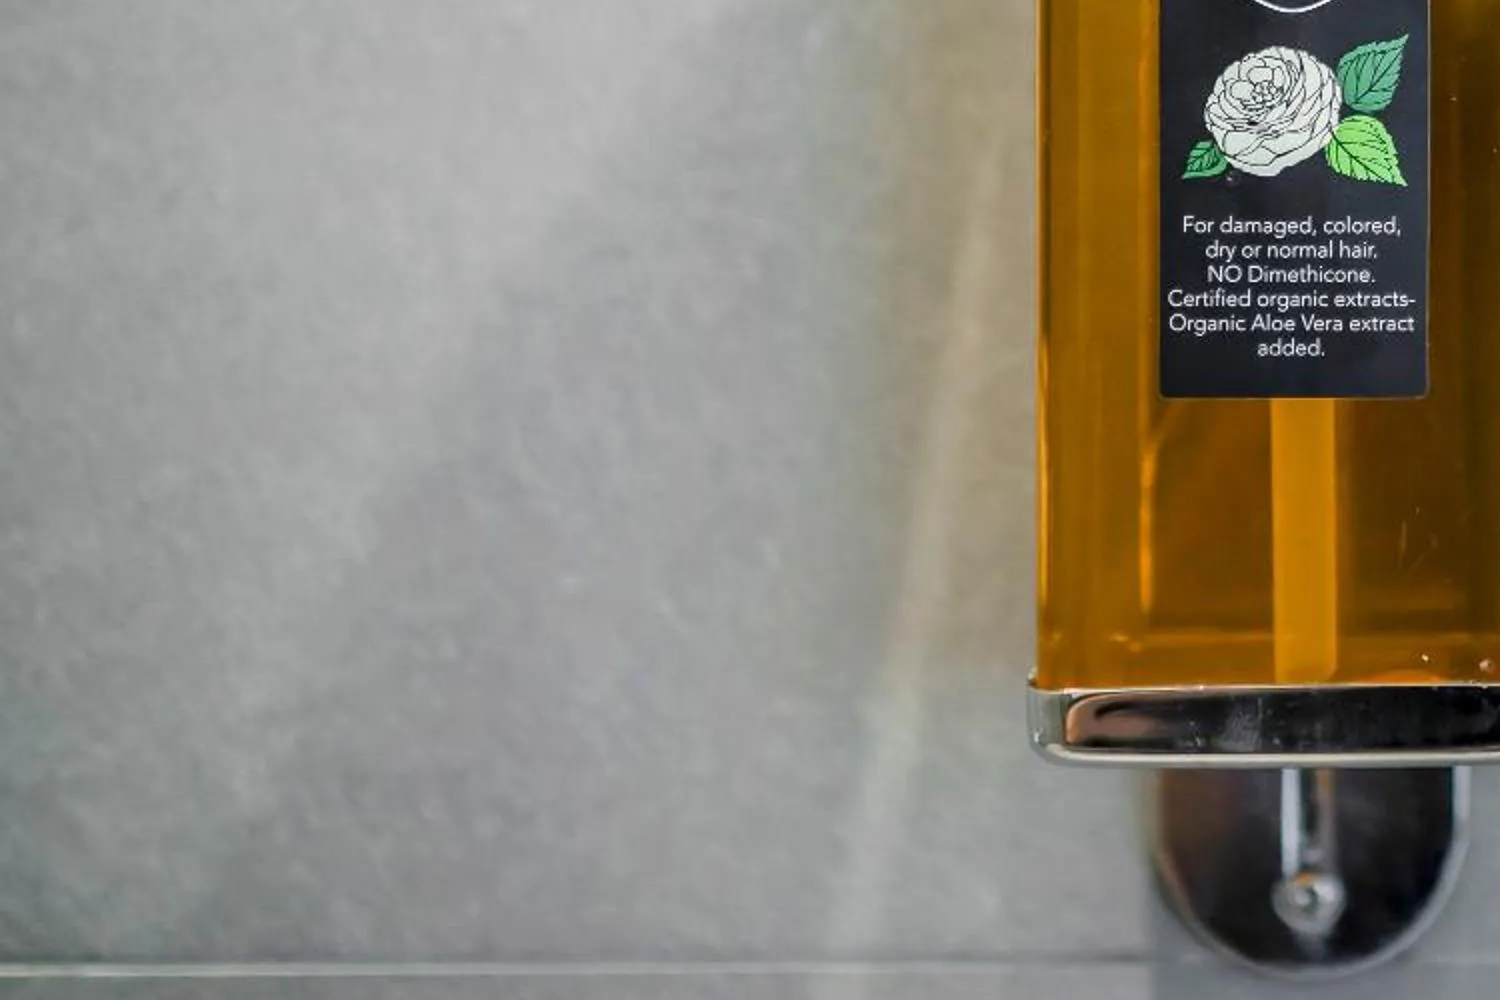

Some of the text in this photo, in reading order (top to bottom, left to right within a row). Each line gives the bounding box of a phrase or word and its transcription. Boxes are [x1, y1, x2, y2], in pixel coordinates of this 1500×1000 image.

[1183, 215, 1401, 238] For damaged, colored,
[1205, 240, 1377, 262] dry or normal hair.
[1207, 265, 1376, 283] NO Dimethicone.
[1168, 288, 1416, 312] Certified organic extracts-
[1169, 313, 1415, 336] Organic Aloe Vera extract
[1257, 338, 1325, 357] added.
